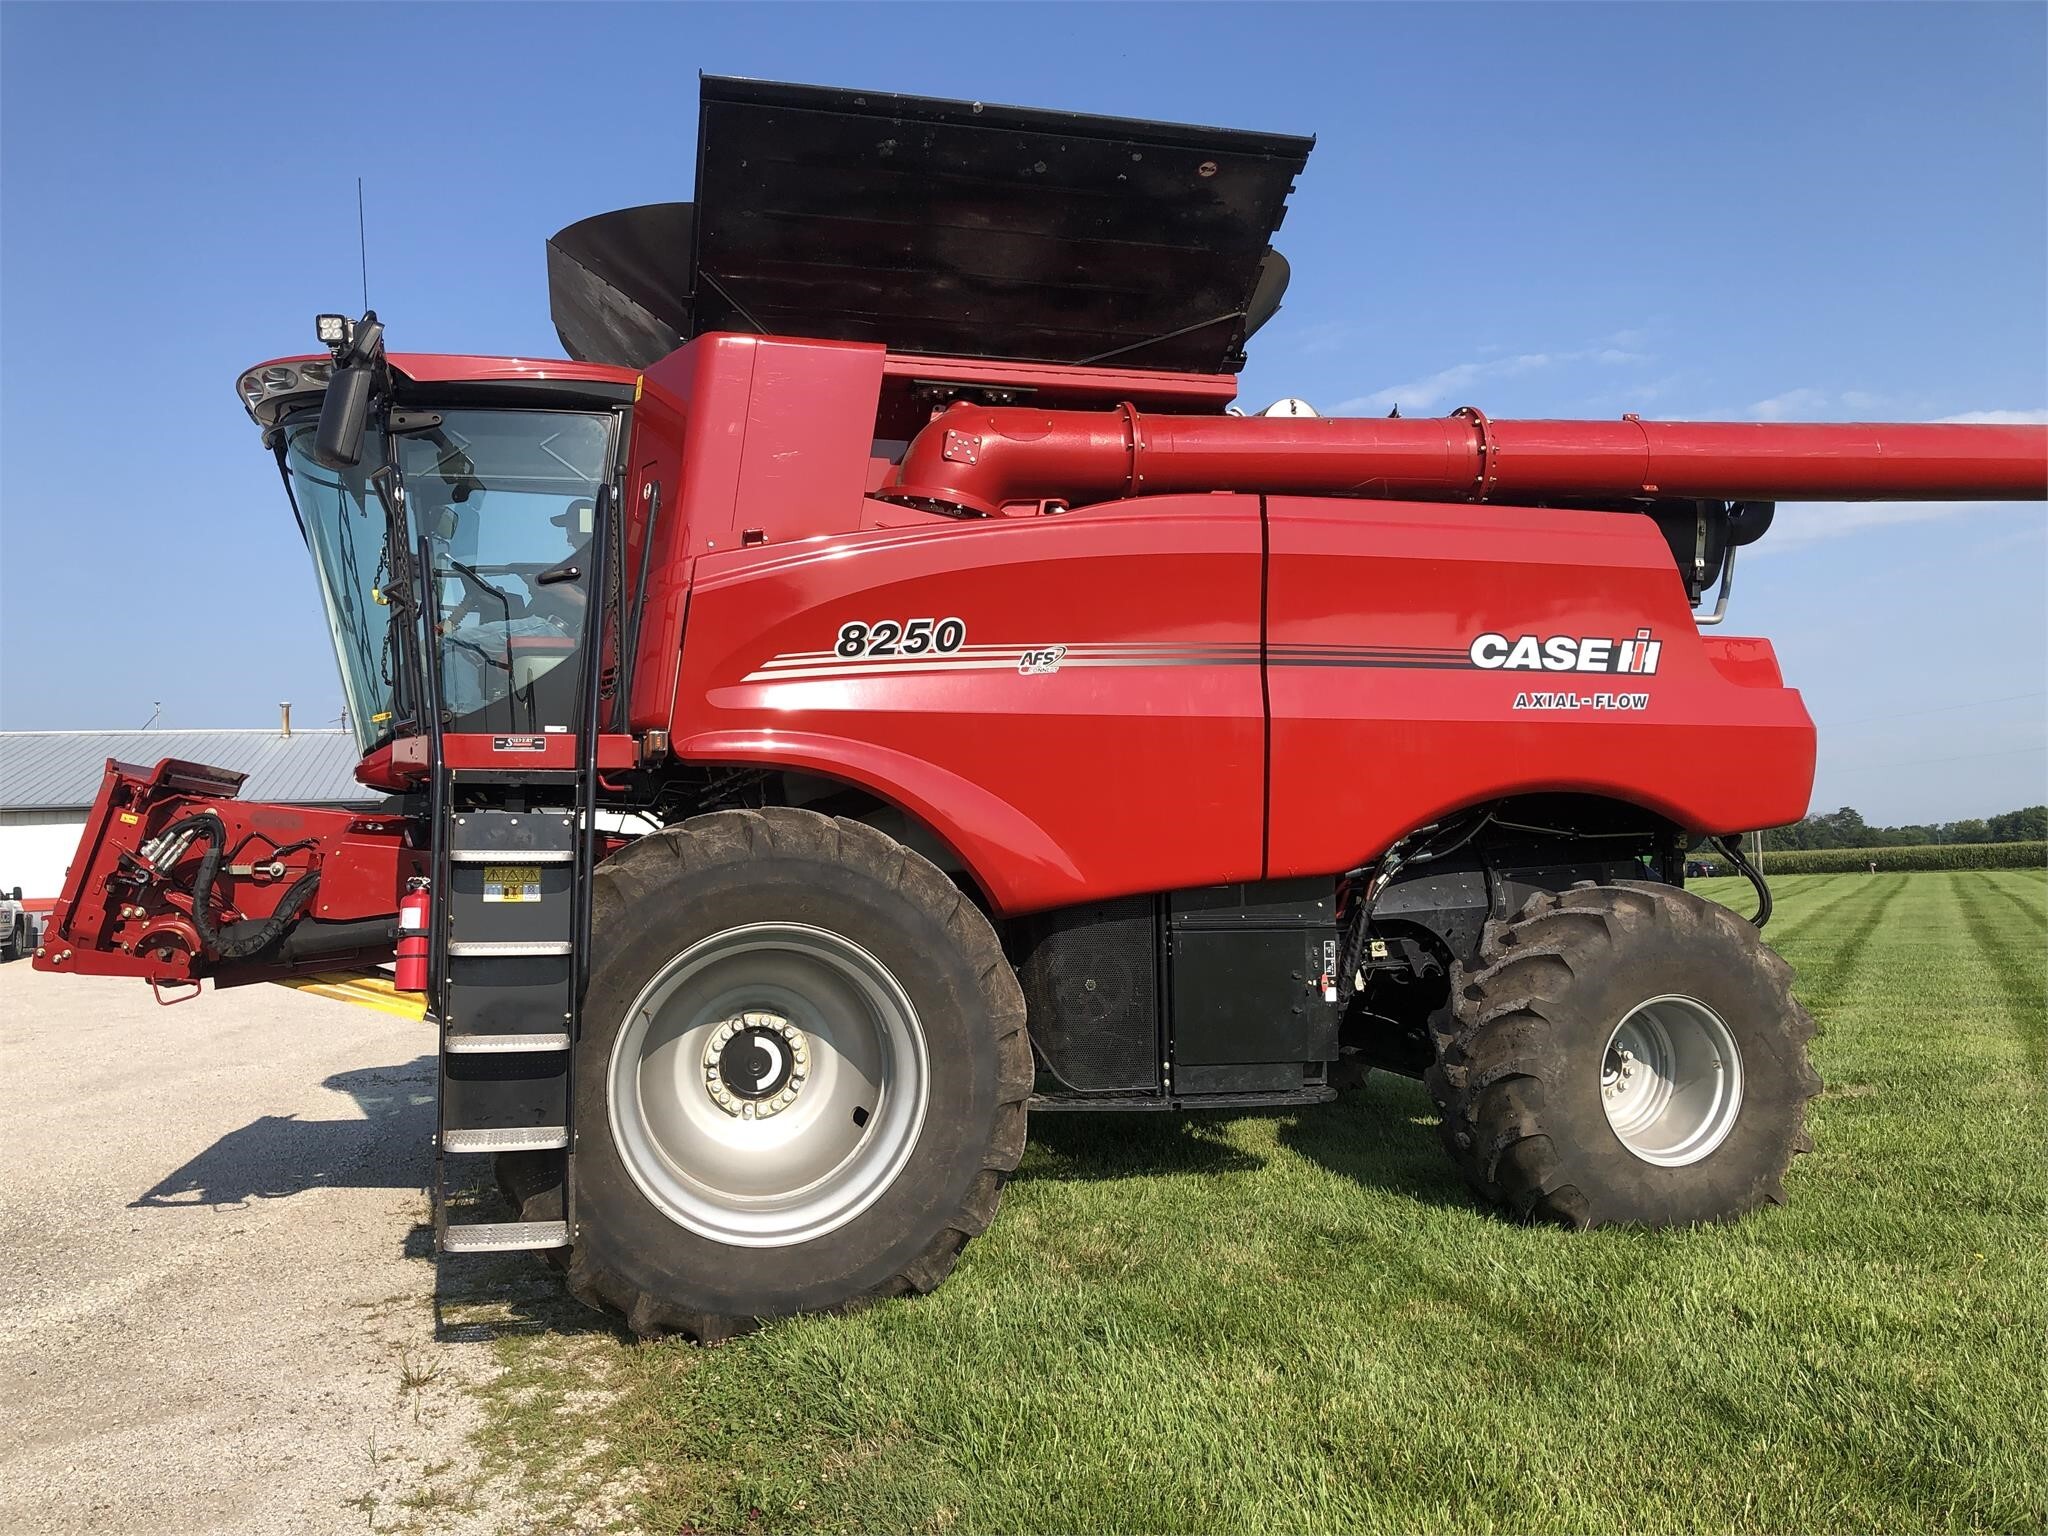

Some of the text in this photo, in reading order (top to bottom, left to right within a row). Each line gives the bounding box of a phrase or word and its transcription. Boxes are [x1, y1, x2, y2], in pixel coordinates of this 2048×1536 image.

[835, 617, 966, 659] 8250
[1470, 632, 1613, 672] CASE
[1020, 651, 1055, 666] AFS
[1513, 692, 1649, 710] AXIAL-FLOW
